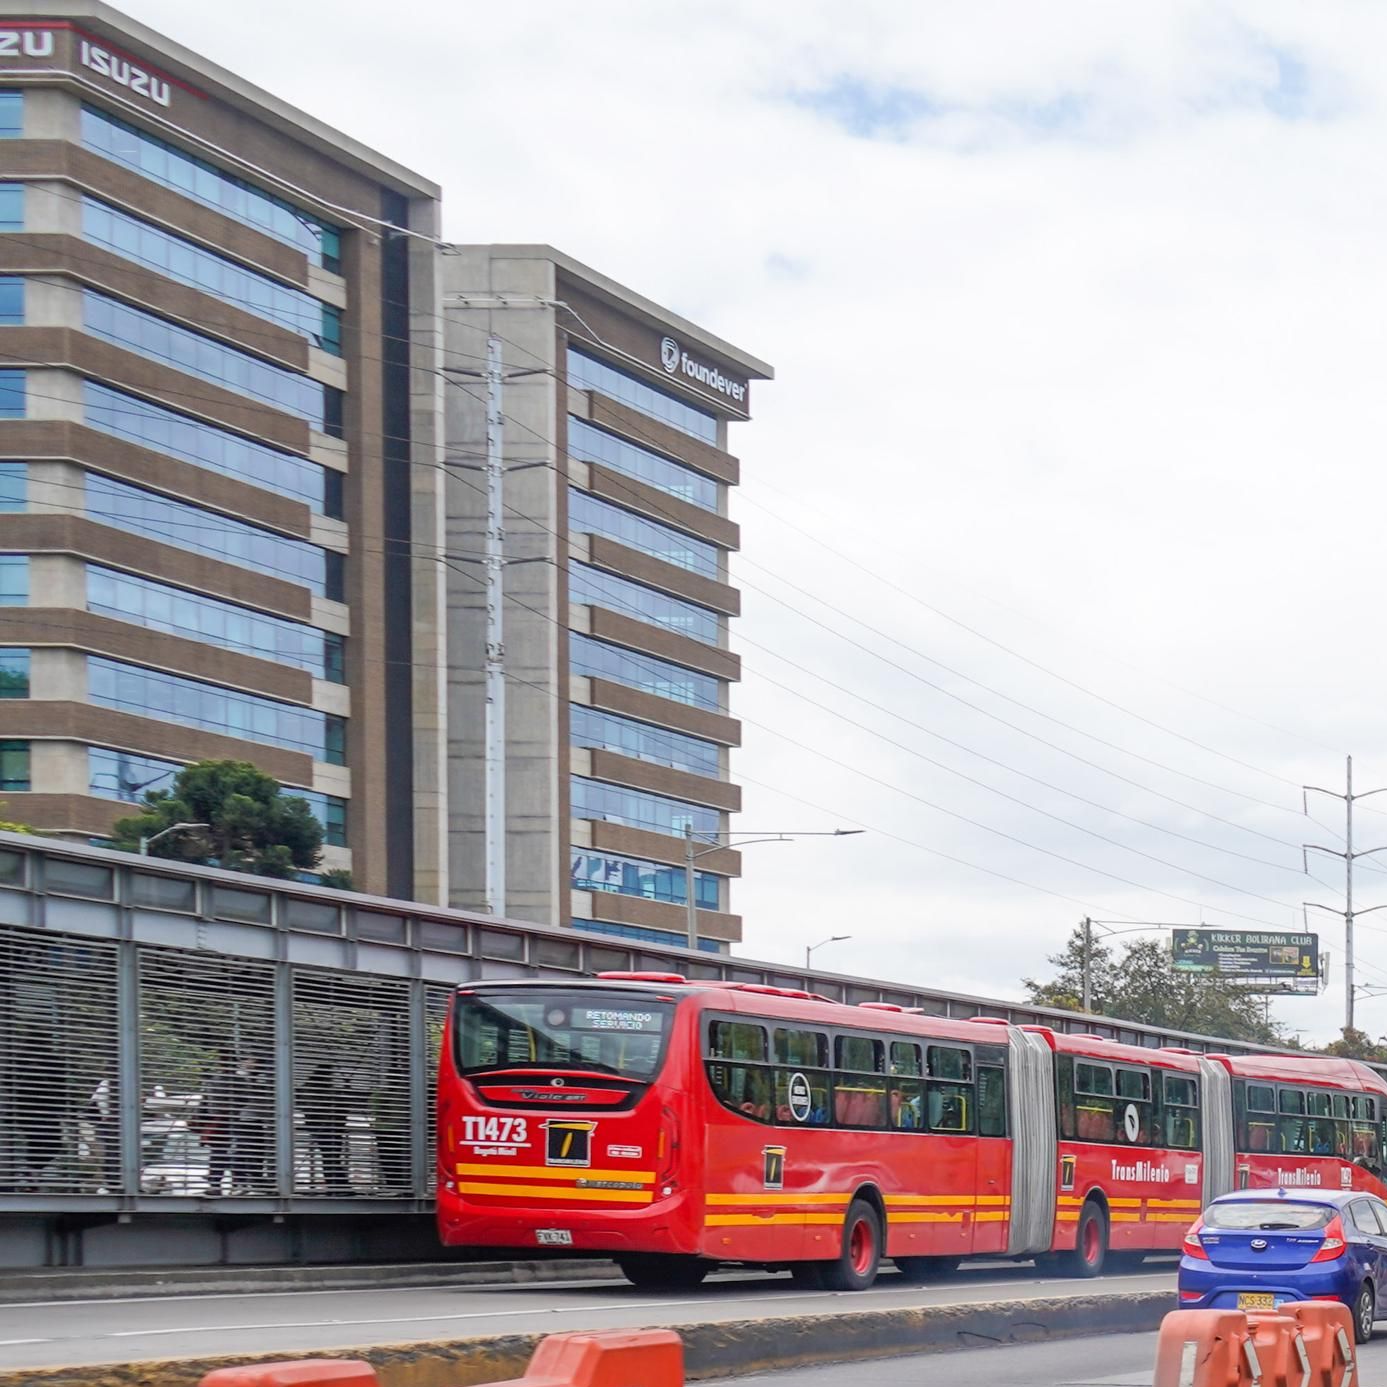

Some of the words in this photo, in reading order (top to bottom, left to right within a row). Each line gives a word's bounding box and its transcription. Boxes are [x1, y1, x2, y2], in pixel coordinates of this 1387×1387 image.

[81, 40, 171, 107] ISUZU
[681, 352, 745, 402] foundever
[1210, 933, 1242, 944] KIKKER
[1246, 935, 1287, 945] BOLIRANA
[1291, 936, 1312, 946] CLUB
[585, 1010, 652, 1022] RETOMANDO
[462, 1115, 528, 1142] T1473
[1111, 1159, 1170, 1182] TransMilenio
[1278, 1168, 1321, 1185] TransMilenio
